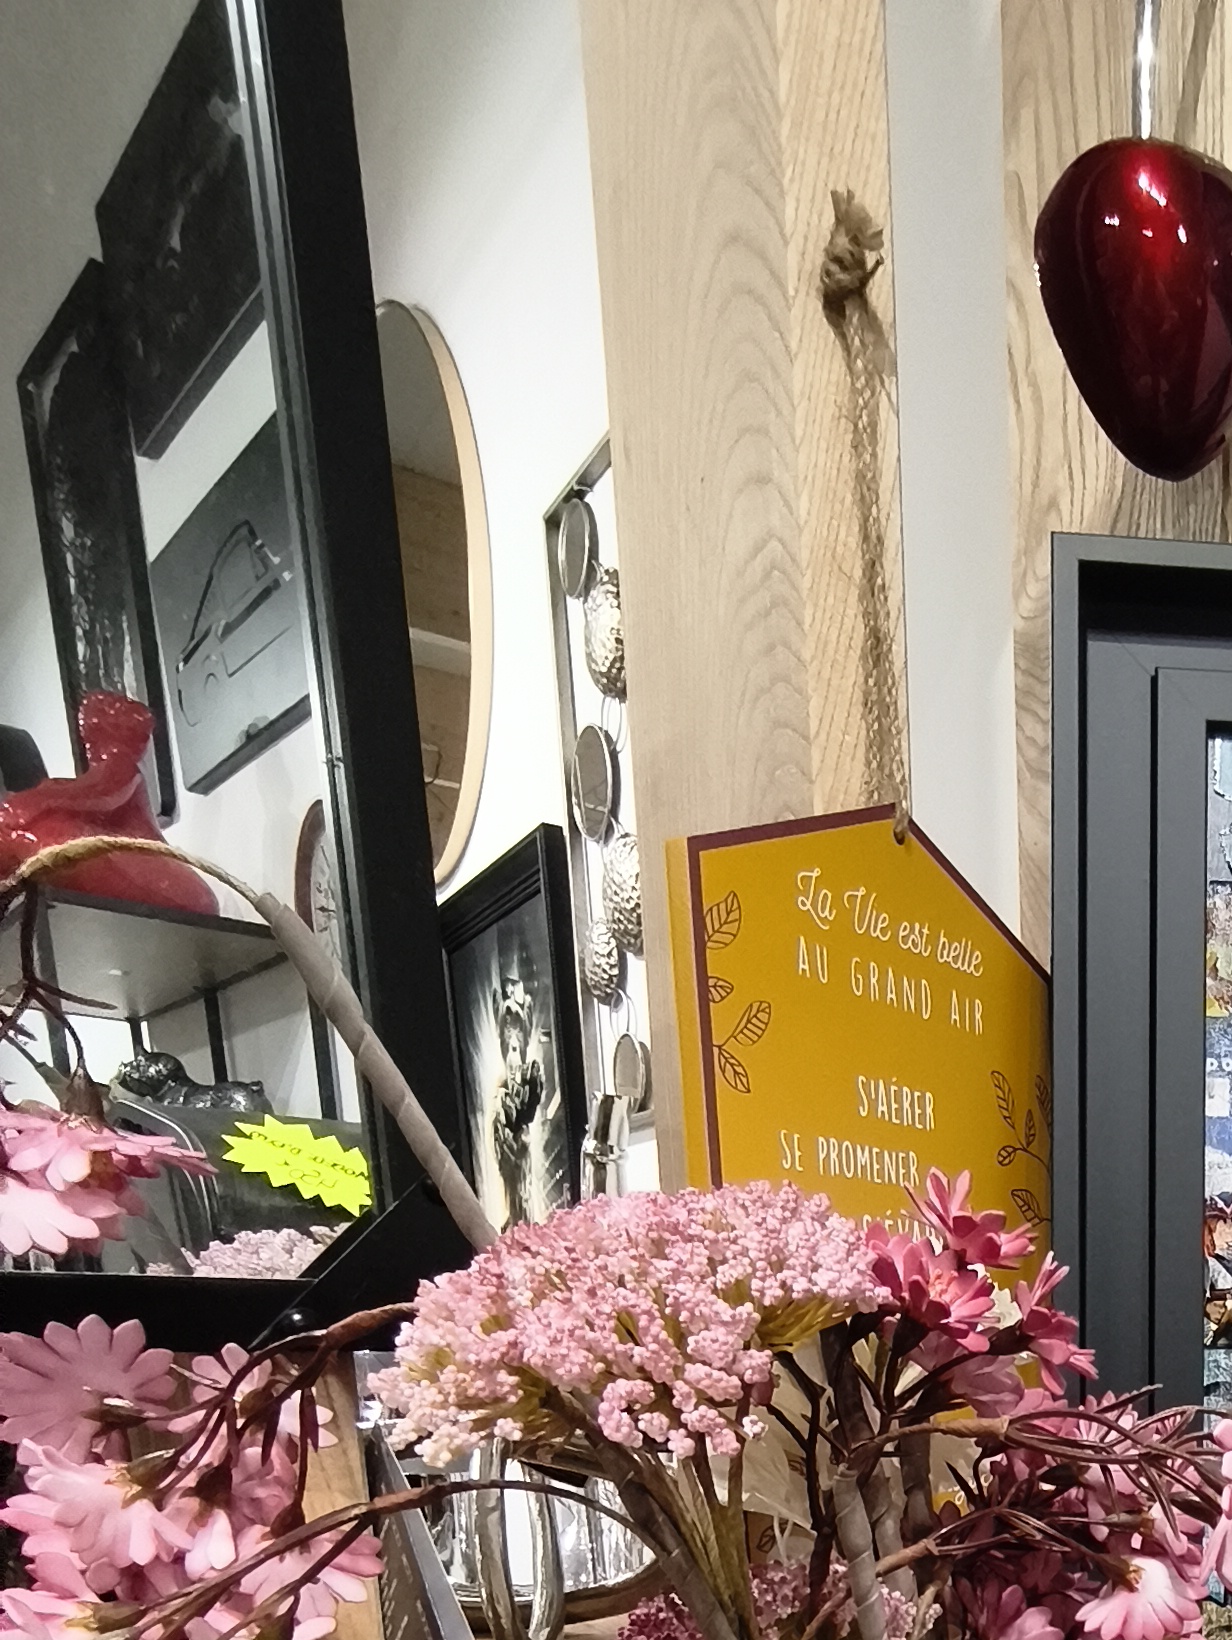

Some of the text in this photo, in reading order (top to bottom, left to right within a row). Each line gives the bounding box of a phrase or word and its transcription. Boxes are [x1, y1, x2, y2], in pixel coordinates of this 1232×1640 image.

[796, 867, 984, 977] La Vie est belle
[797, 935, 984, 1036] AU GRAND AIR
[856, 1075, 936, 1131] S'AÉRER
[779, 1129, 920, 1187] SE PROMENER
